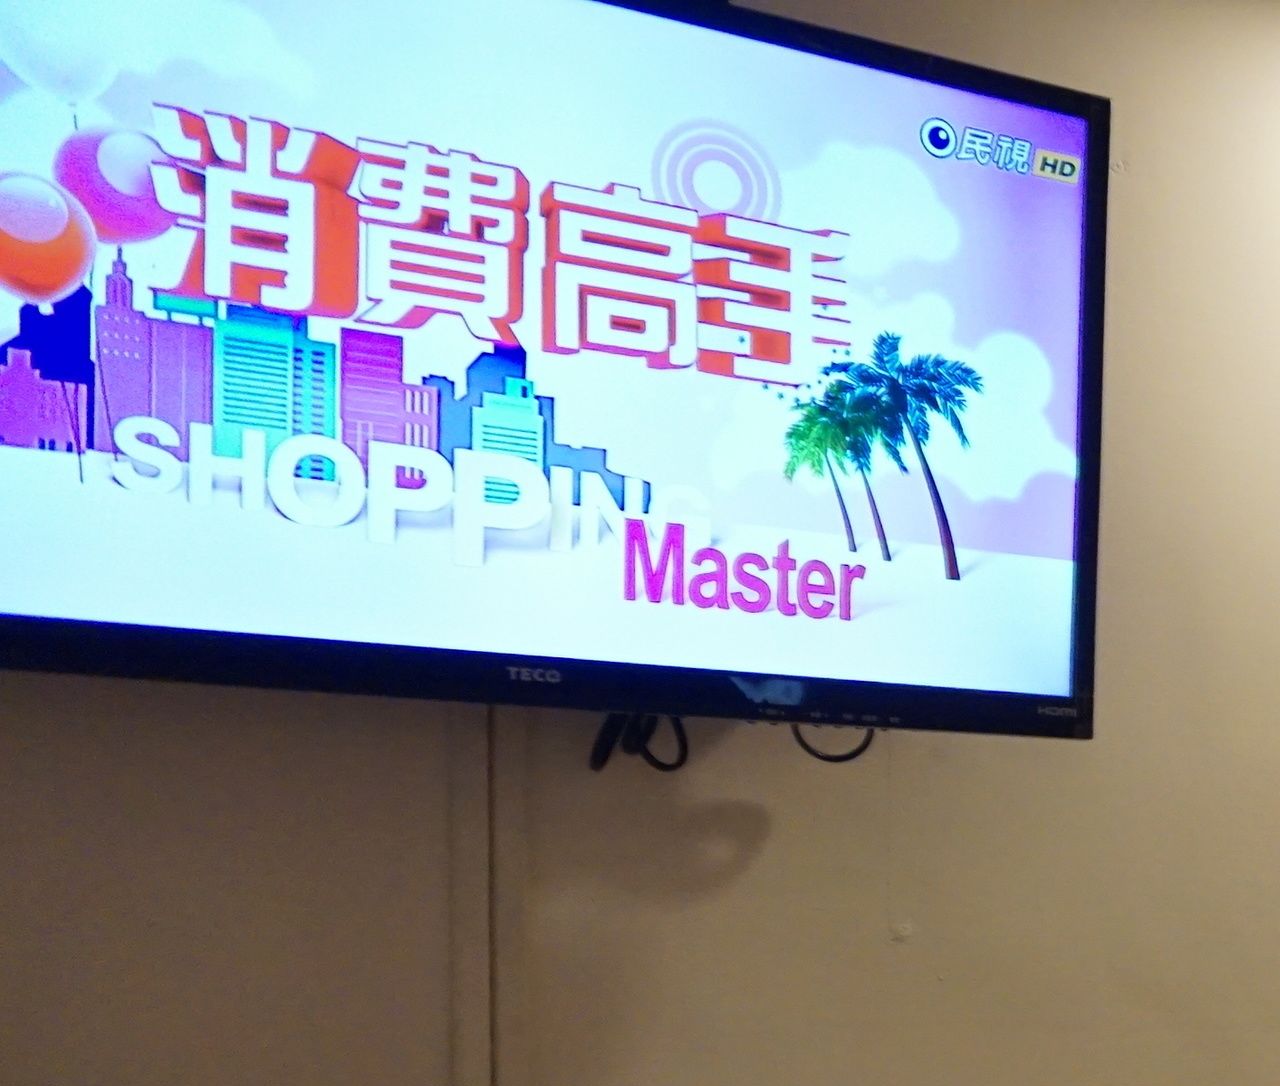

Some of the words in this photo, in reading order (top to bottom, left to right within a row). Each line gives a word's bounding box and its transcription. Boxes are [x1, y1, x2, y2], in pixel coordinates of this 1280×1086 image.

[956, 126, 1033, 175] 民視
[1038, 156, 1076, 179] HD
[133, 102, 850, 388] 消費高手
[622, 517, 866, 621] Master
[505, 666, 561, 683] TECO
[1036, 704, 1078, 718] HDMI
